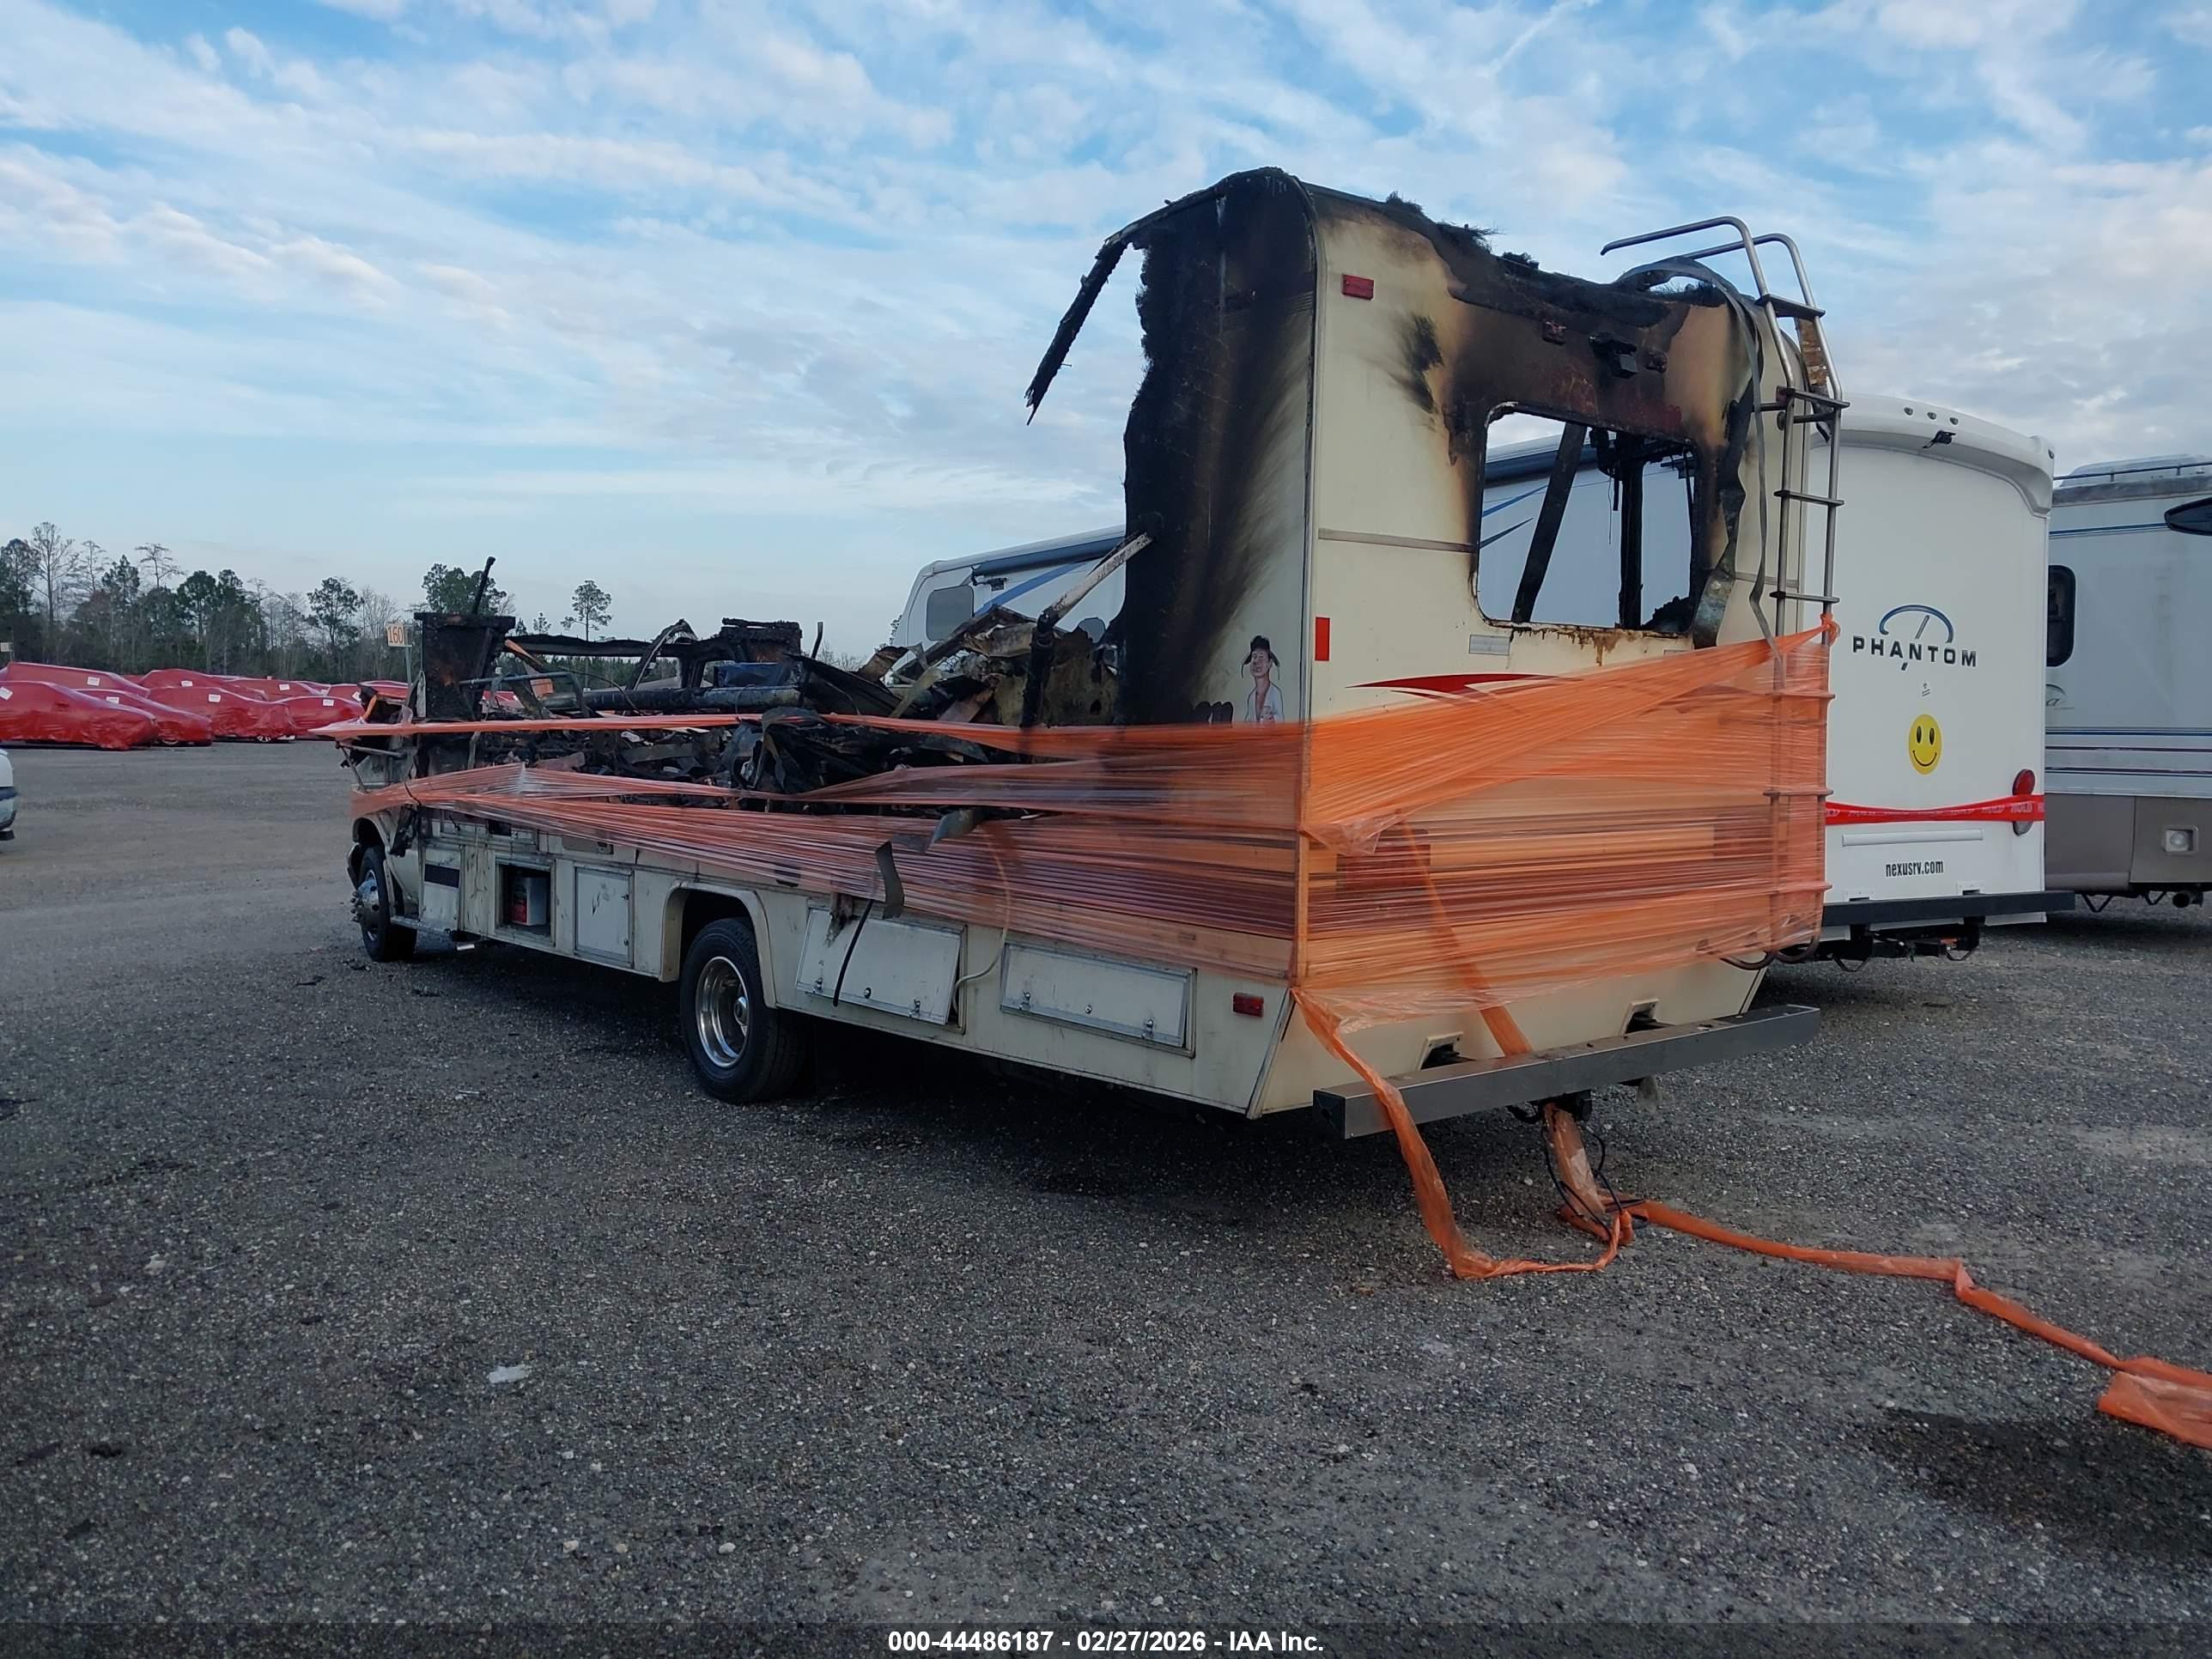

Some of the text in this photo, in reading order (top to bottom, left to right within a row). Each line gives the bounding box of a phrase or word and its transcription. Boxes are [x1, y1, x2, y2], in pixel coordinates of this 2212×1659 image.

[388, 627, 404, 643] 160
[1852, 635, 1977, 667] PHANTOM
[1886, 860, 1944, 877] nexusrv.com
